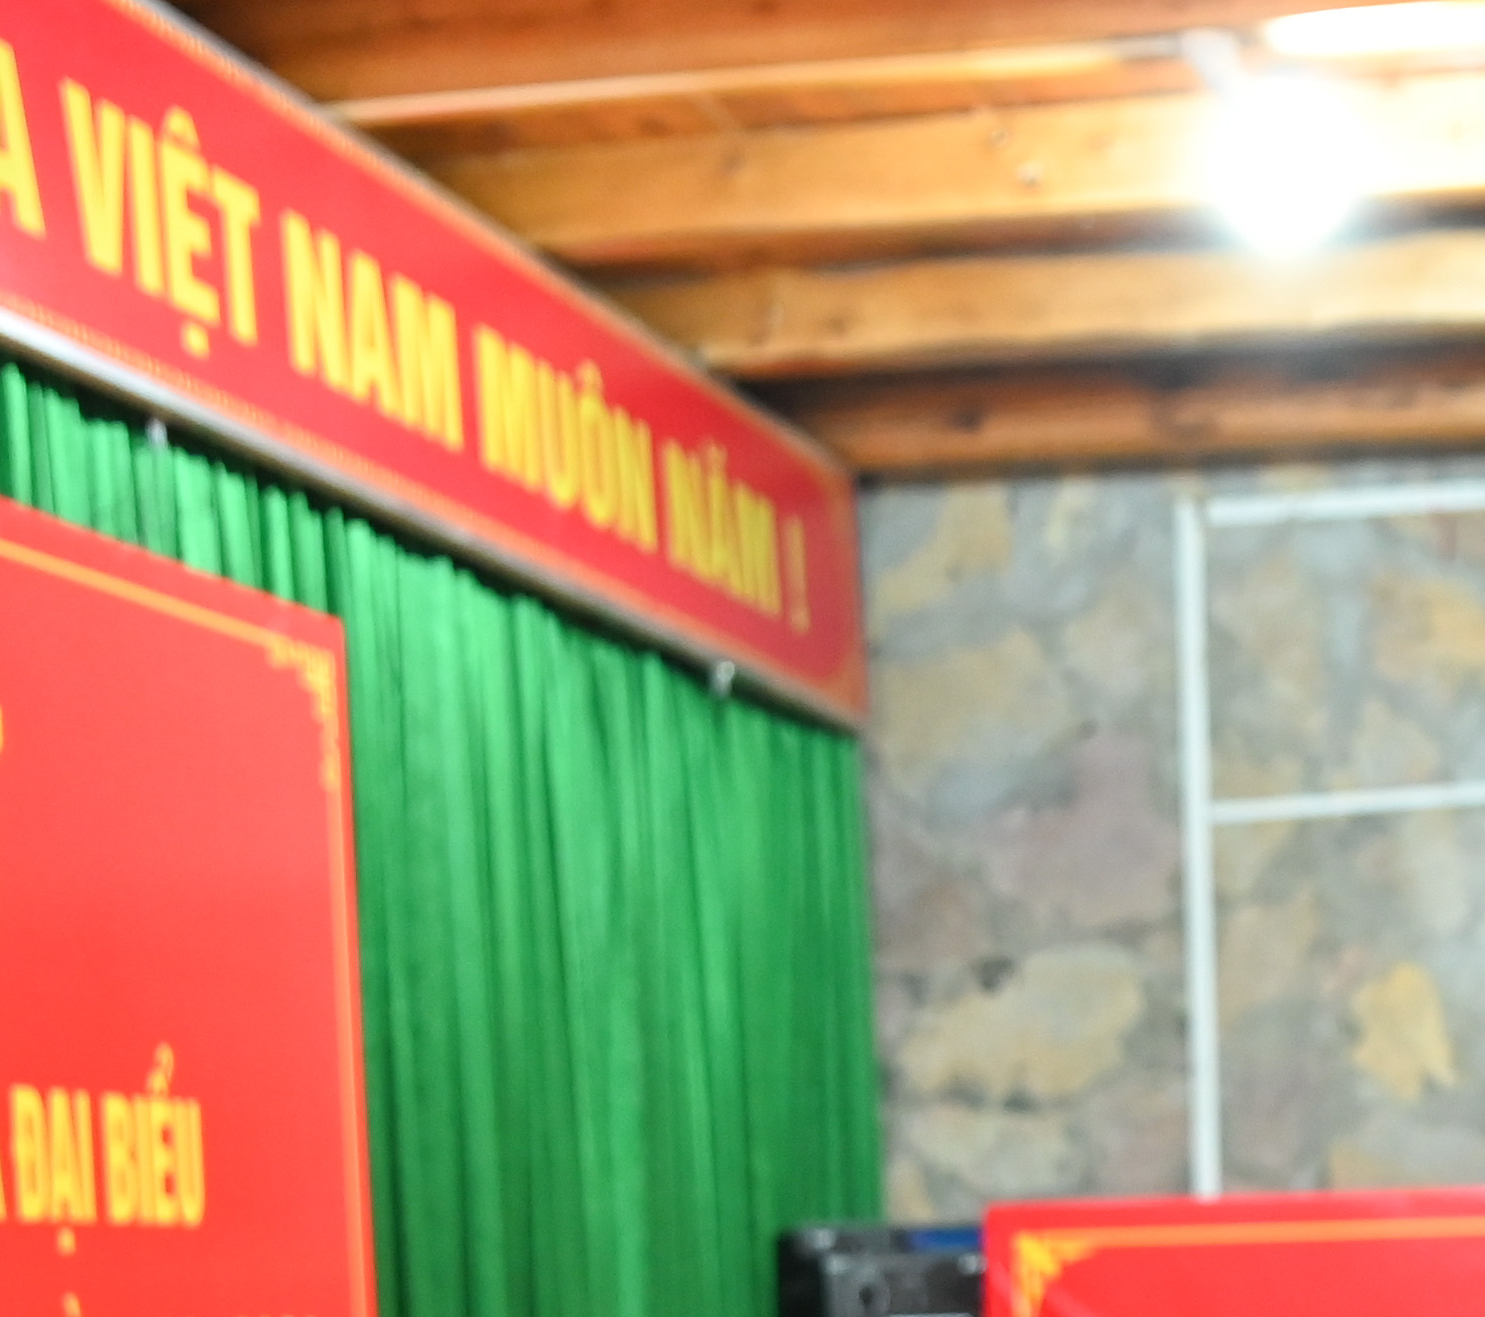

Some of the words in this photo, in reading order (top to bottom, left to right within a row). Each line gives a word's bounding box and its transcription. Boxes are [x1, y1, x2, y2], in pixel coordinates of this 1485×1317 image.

[61, 78, 262, 358] VIỆT
[281, 210, 465, 451] NAM
[473, 325, 658, 551] MUÔN
[663, 440, 781, 615] NĂM
[10, 1083, 97, 1254] ĐẠI
[101, 1043, 205, 1228] BIỂU
